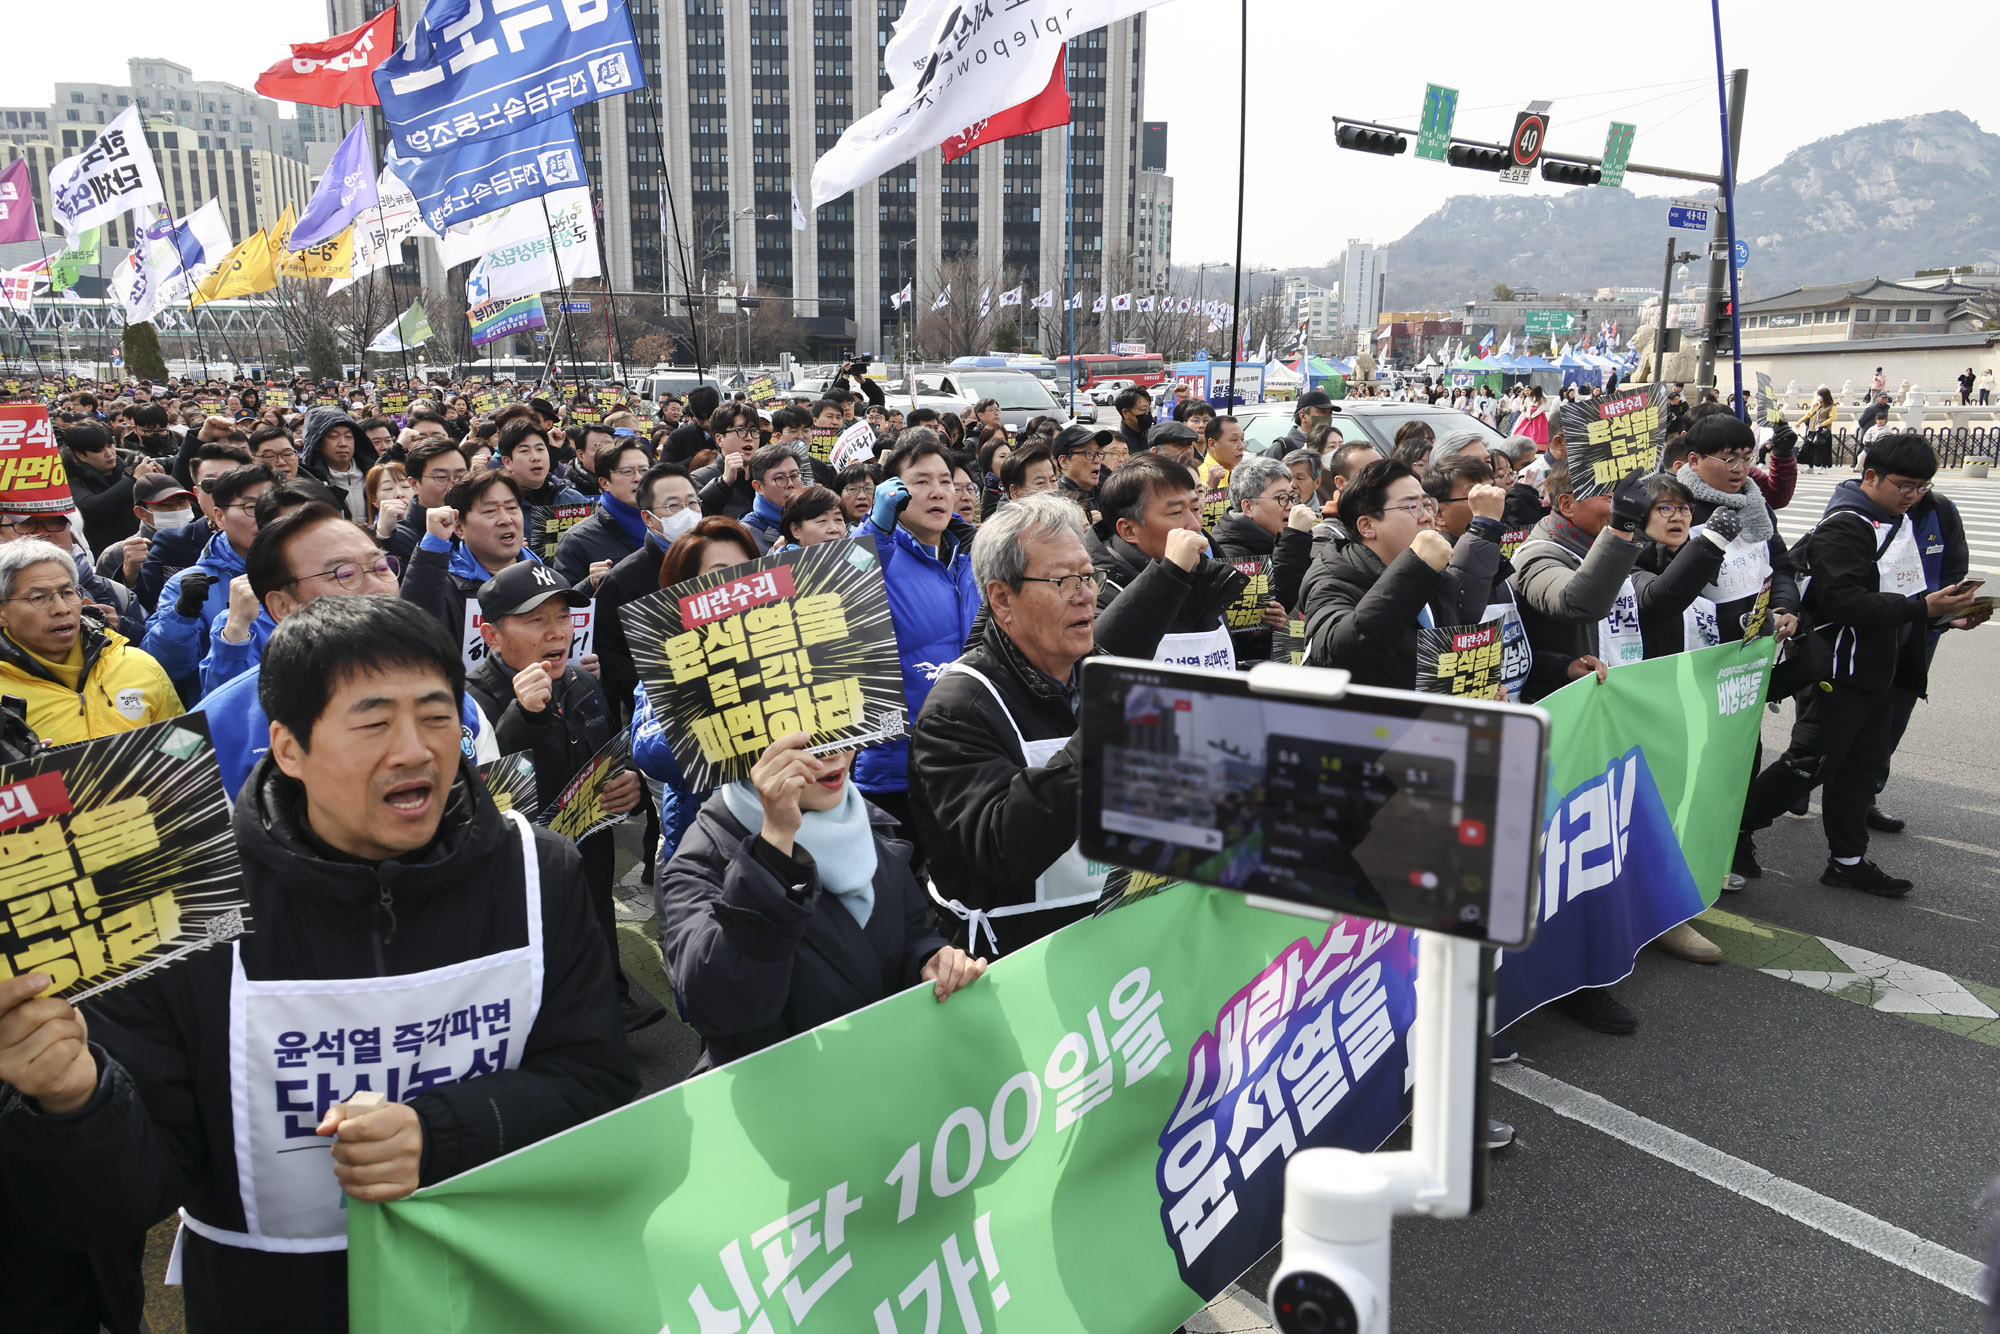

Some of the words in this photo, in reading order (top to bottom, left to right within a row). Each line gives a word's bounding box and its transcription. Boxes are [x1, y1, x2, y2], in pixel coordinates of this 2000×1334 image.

[1521, 129, 1538, 152] 40
[1501, 169, 1530, 182] 도심부
[1686, 210, 1707, 221] 세종대로
[1604, 395, 1643, 415] 내란수괴
[1587, 406, 1659, 446] 윤석열을
[531, 566, 556, 586] NY
[688, 572, 778, 621] 내란수괴
[664, 592, 850, 685] 윤석열을
[1457, 630, 1490, 649] 내란수괴
[1437, 641, 1503, 679] 윤석열을
[691, 676, 866, 764] 파면하라
[274, 1026, 382, 1069] 윤석열
[392, 998, 511, 1057] 즉각파면
[1163, 960, 1396, 1268] 윤석열을
